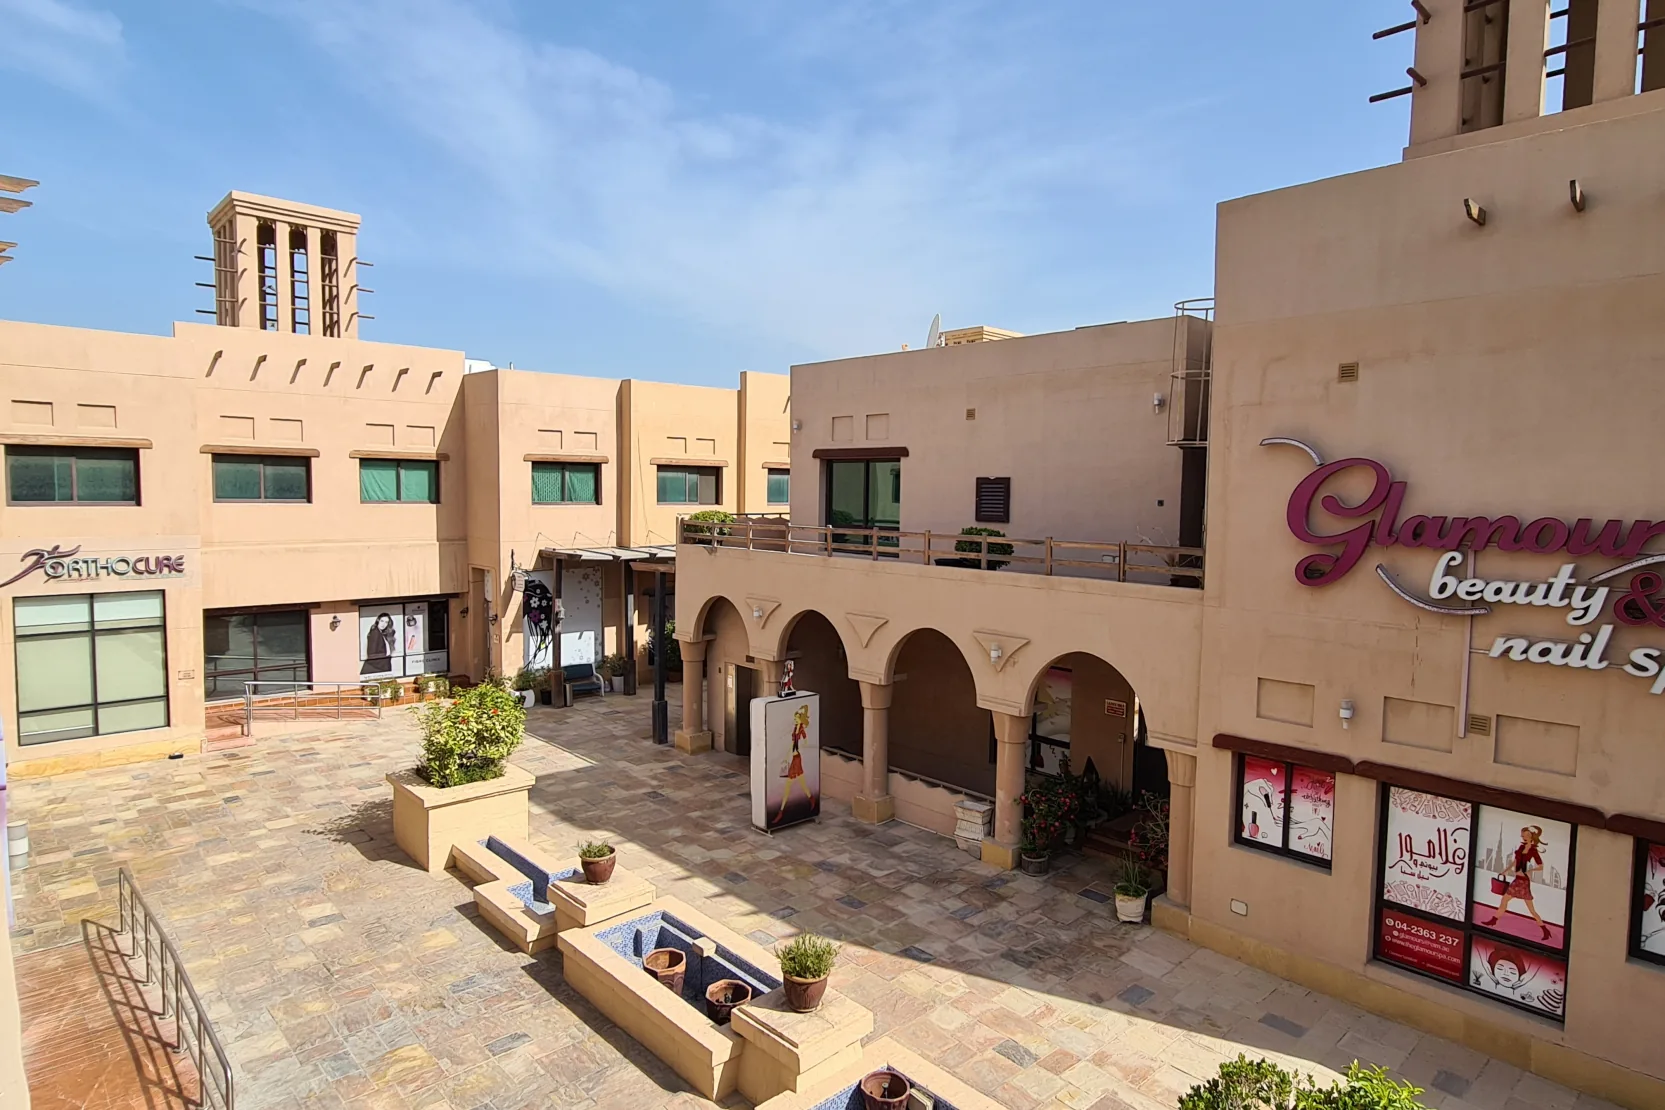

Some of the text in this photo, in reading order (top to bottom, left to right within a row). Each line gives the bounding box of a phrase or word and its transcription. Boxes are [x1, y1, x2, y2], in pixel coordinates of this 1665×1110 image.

[1286, 457, 1665, 587] Glamour
[44, 555, 185, 578] ORTHOCURE
[1428, 551, 1665, 629] beauty &
[1488, 624, 1614, 670] nail
[1398, 827, 1467, 875] غلامور
[1395, 920, 1460, 947] 04-2363 237
